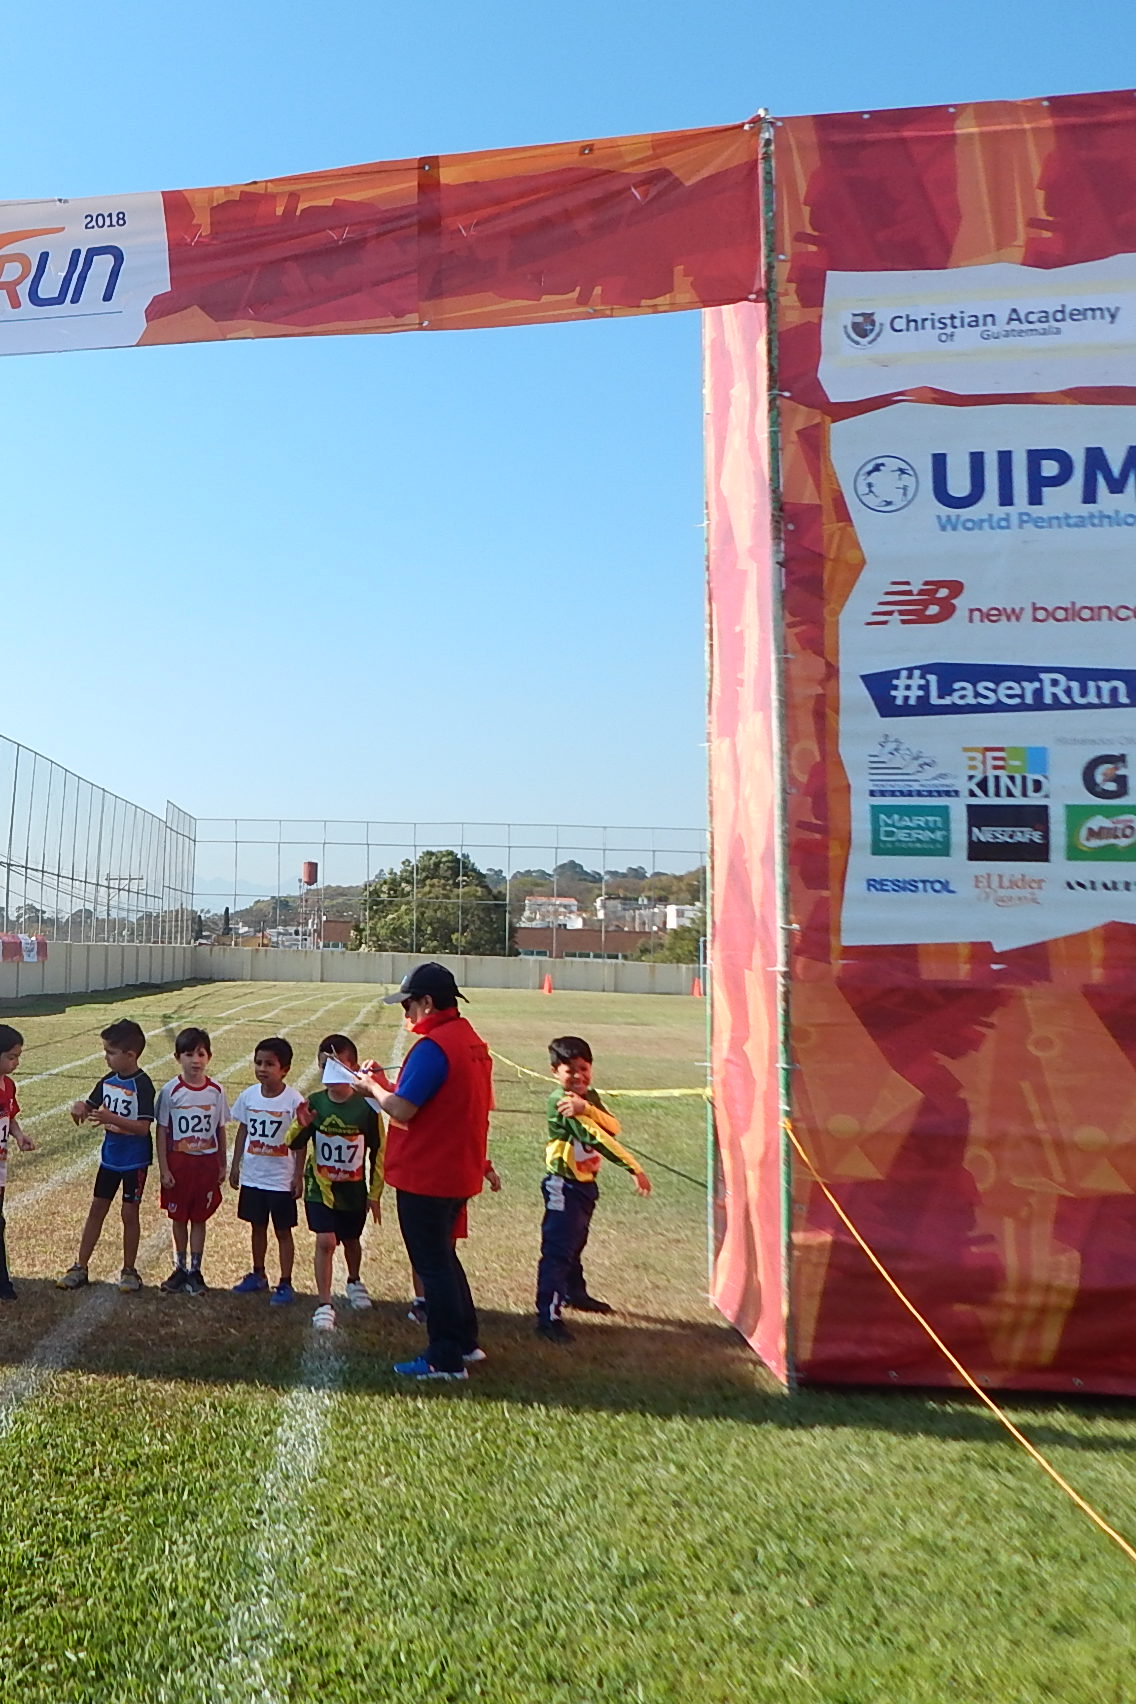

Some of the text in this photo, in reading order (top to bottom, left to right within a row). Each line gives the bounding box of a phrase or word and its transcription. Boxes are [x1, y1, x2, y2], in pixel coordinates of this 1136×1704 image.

[84, 212, 126, 230] 2018
[889, 303, 1122, 334] Christian Academy
[938, 324, 1062, 344] Of Guatemala
[930, 444, 1136, 510] UIPM
[936, 512, 1012, 534] World
[968, 600, 1136, 624] new balanc
[890, 669, 1131, 706] #LaserRun
[964, 774, 1050, 798] KIND
[878, 813, 944, 828] MARTI
[1086, 824, 1135, 842] MILO
[866, 878, 957, 894] RESISTOL
[974, 872, 992, 889] El
[178, 1114, 212, 1134] 023
[249, 1118, 283, 1139] 317
[321, 1142, 359, 1164] 017
